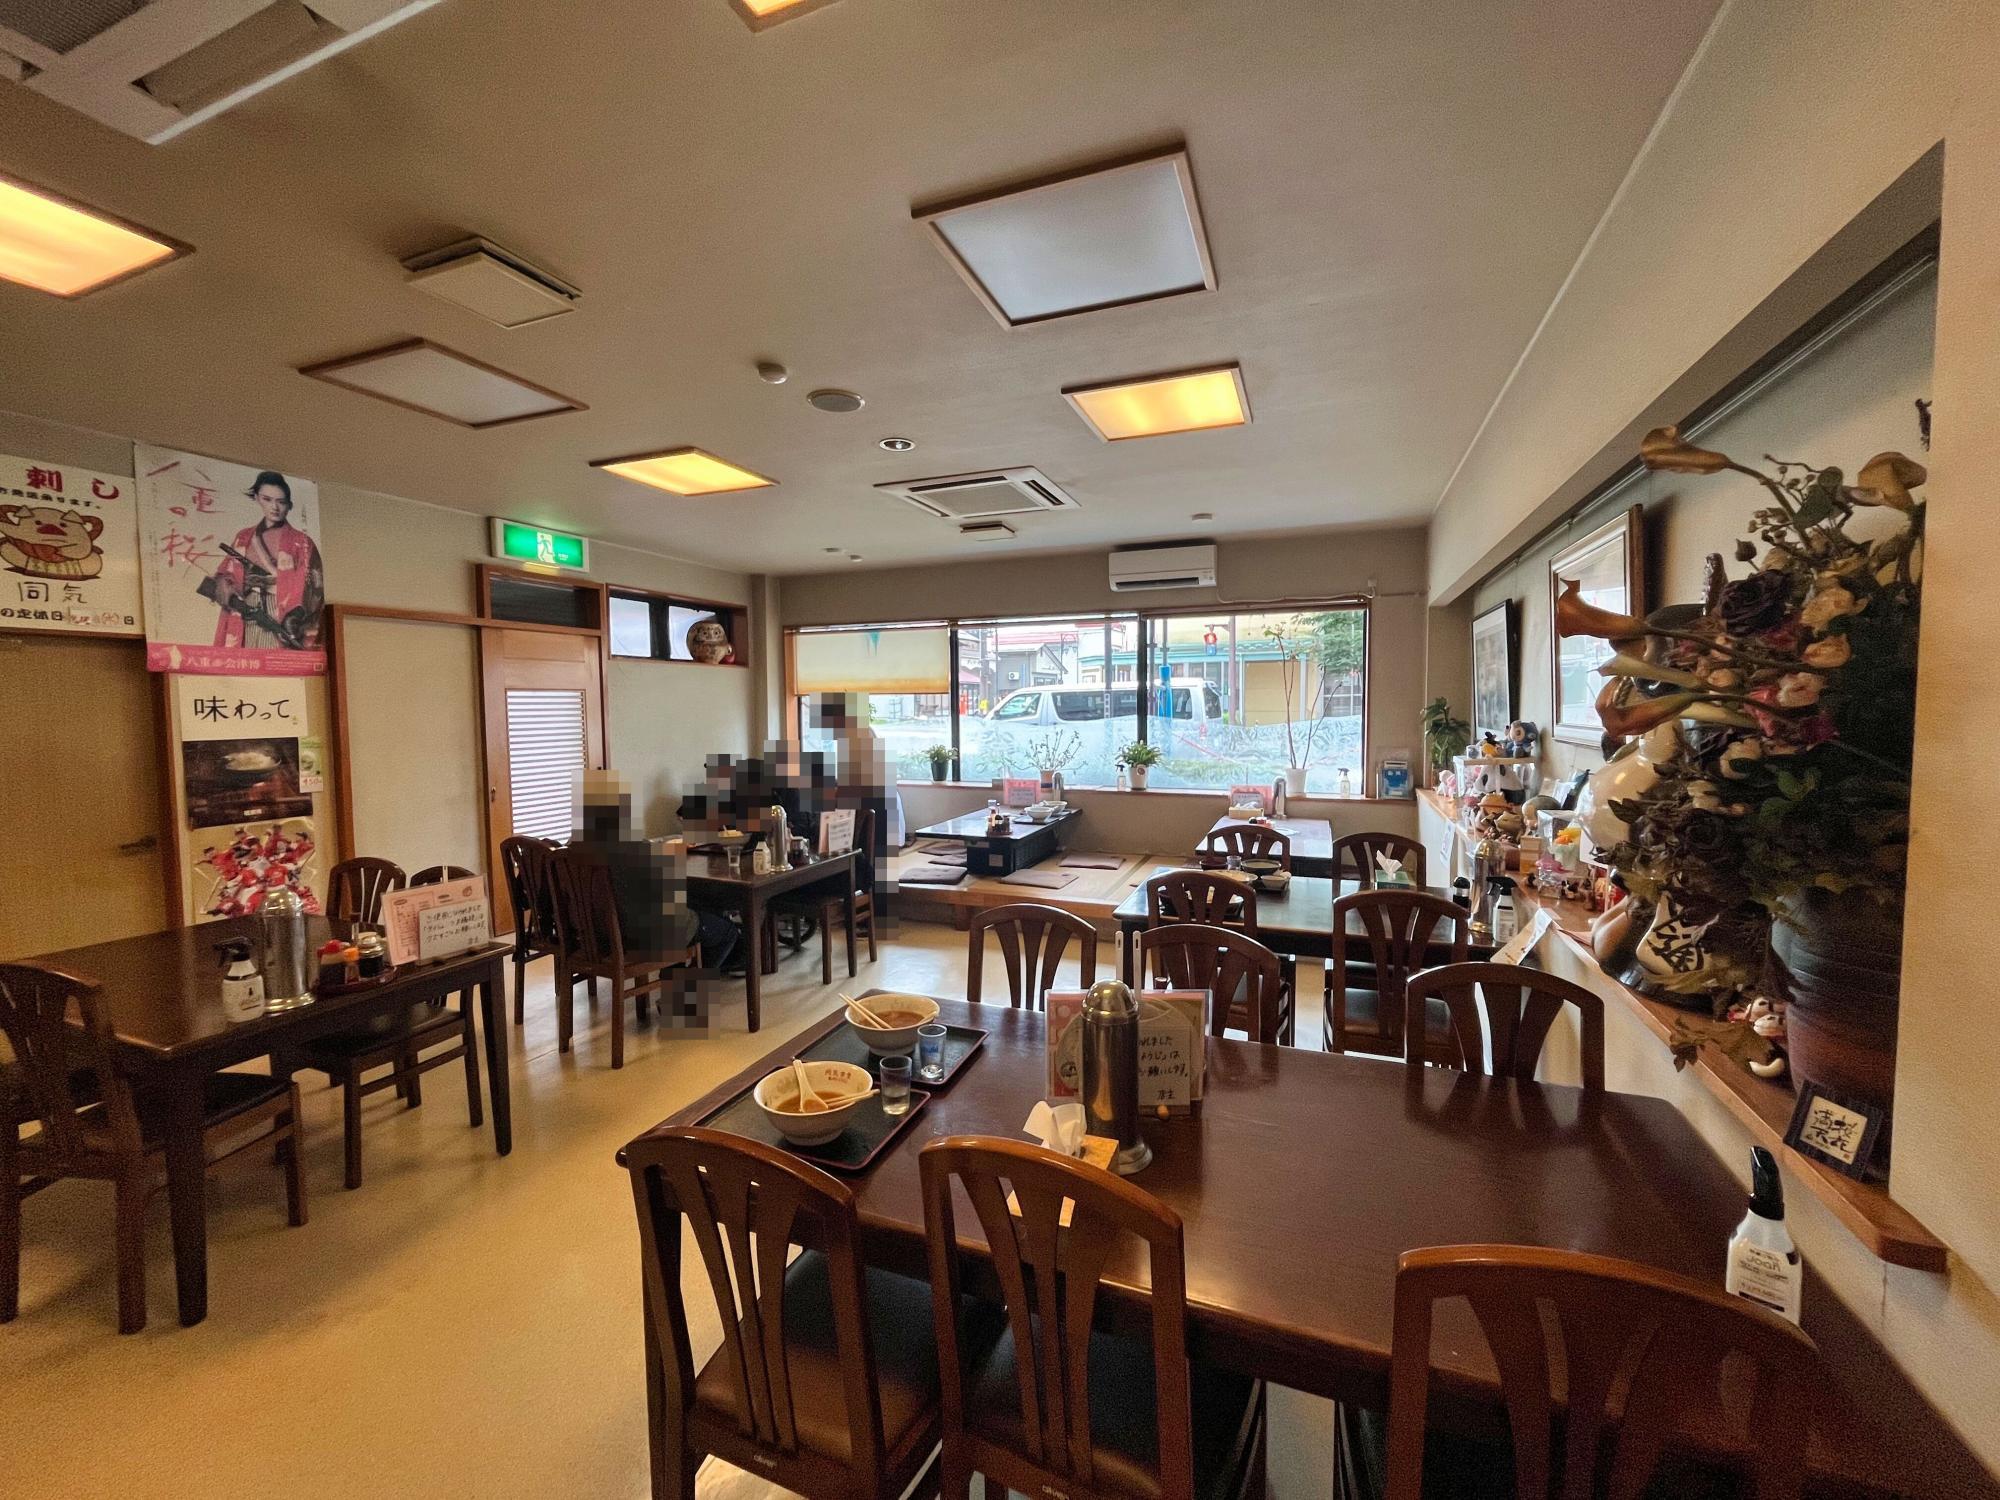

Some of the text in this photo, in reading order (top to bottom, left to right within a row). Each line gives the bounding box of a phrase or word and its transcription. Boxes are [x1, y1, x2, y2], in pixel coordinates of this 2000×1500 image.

[0, 607, 64, 621] の定休日
[123, 615, 135, 626] 日
[193, 695, 291, 722] 味わって
